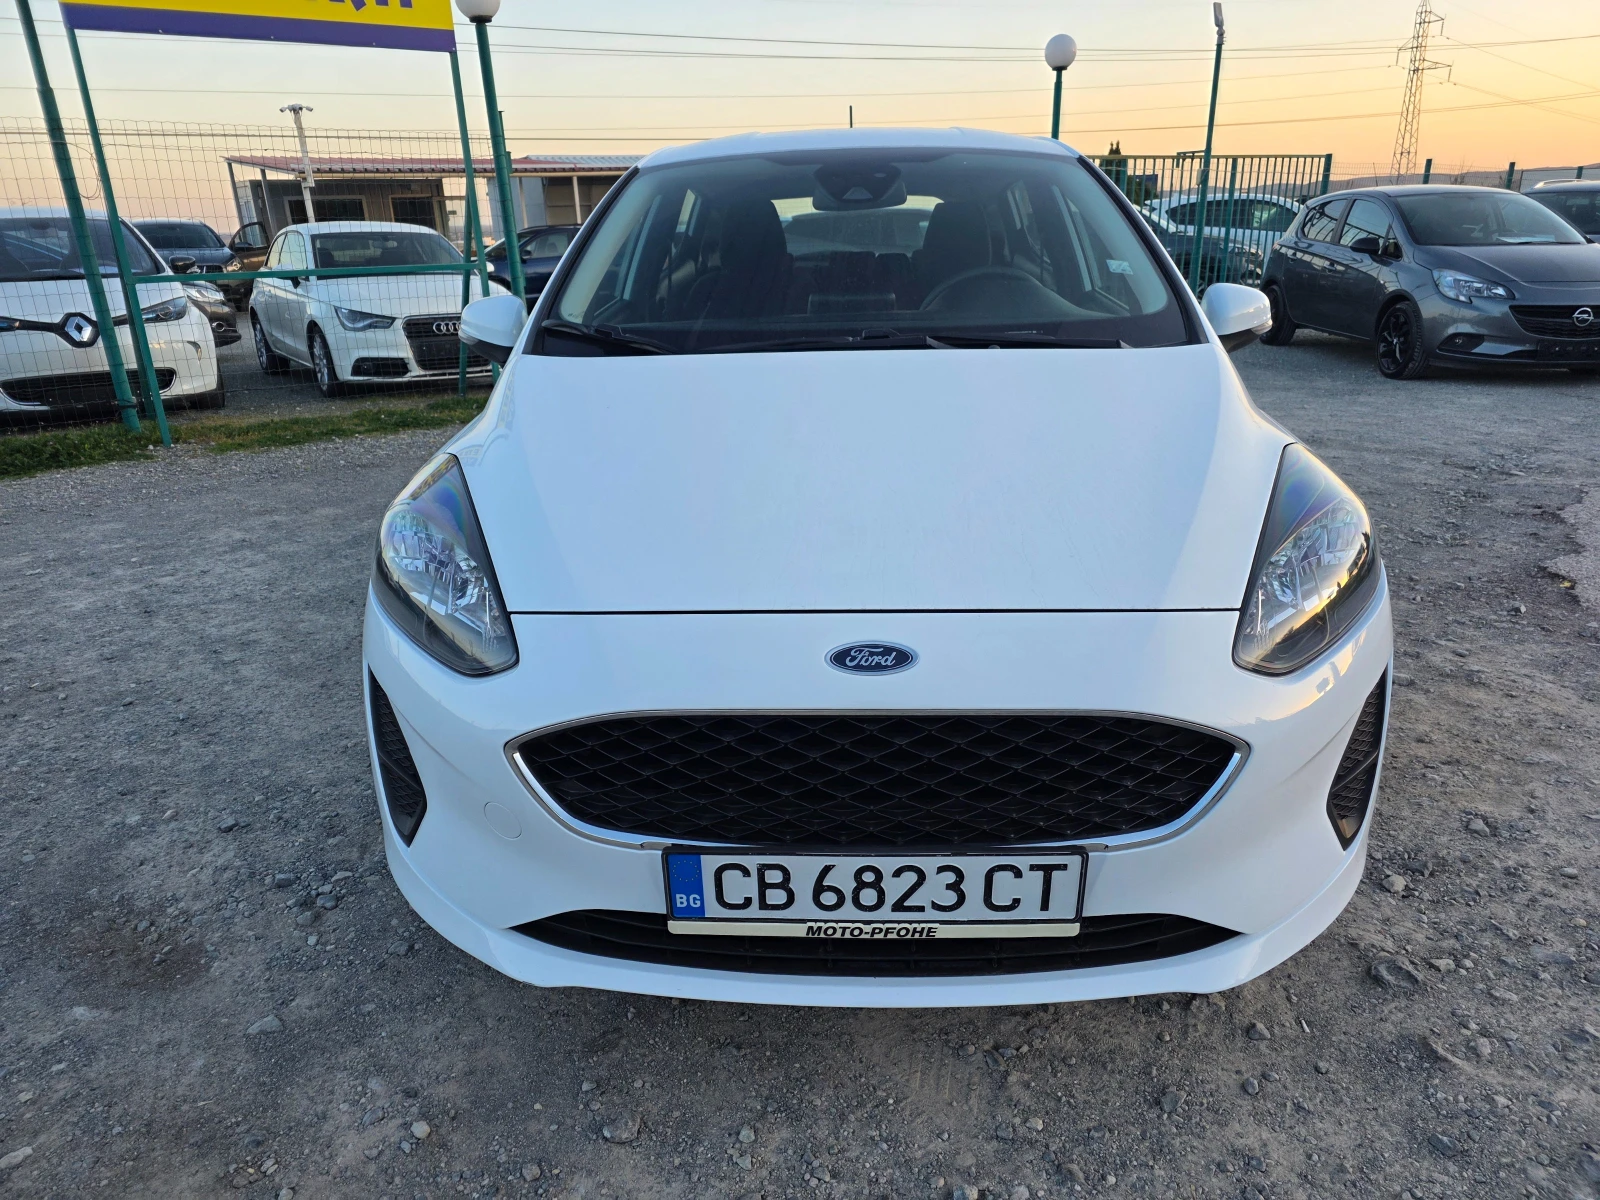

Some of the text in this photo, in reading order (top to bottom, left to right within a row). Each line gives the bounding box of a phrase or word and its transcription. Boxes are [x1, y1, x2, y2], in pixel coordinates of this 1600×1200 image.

[845, 647, 897, 667] Ford
[713, 862, 1069, 913] CB 6823 CT
[675, 893, 702, 908] BG
[805, 925, 939, 938] MOTO-PFOHE
